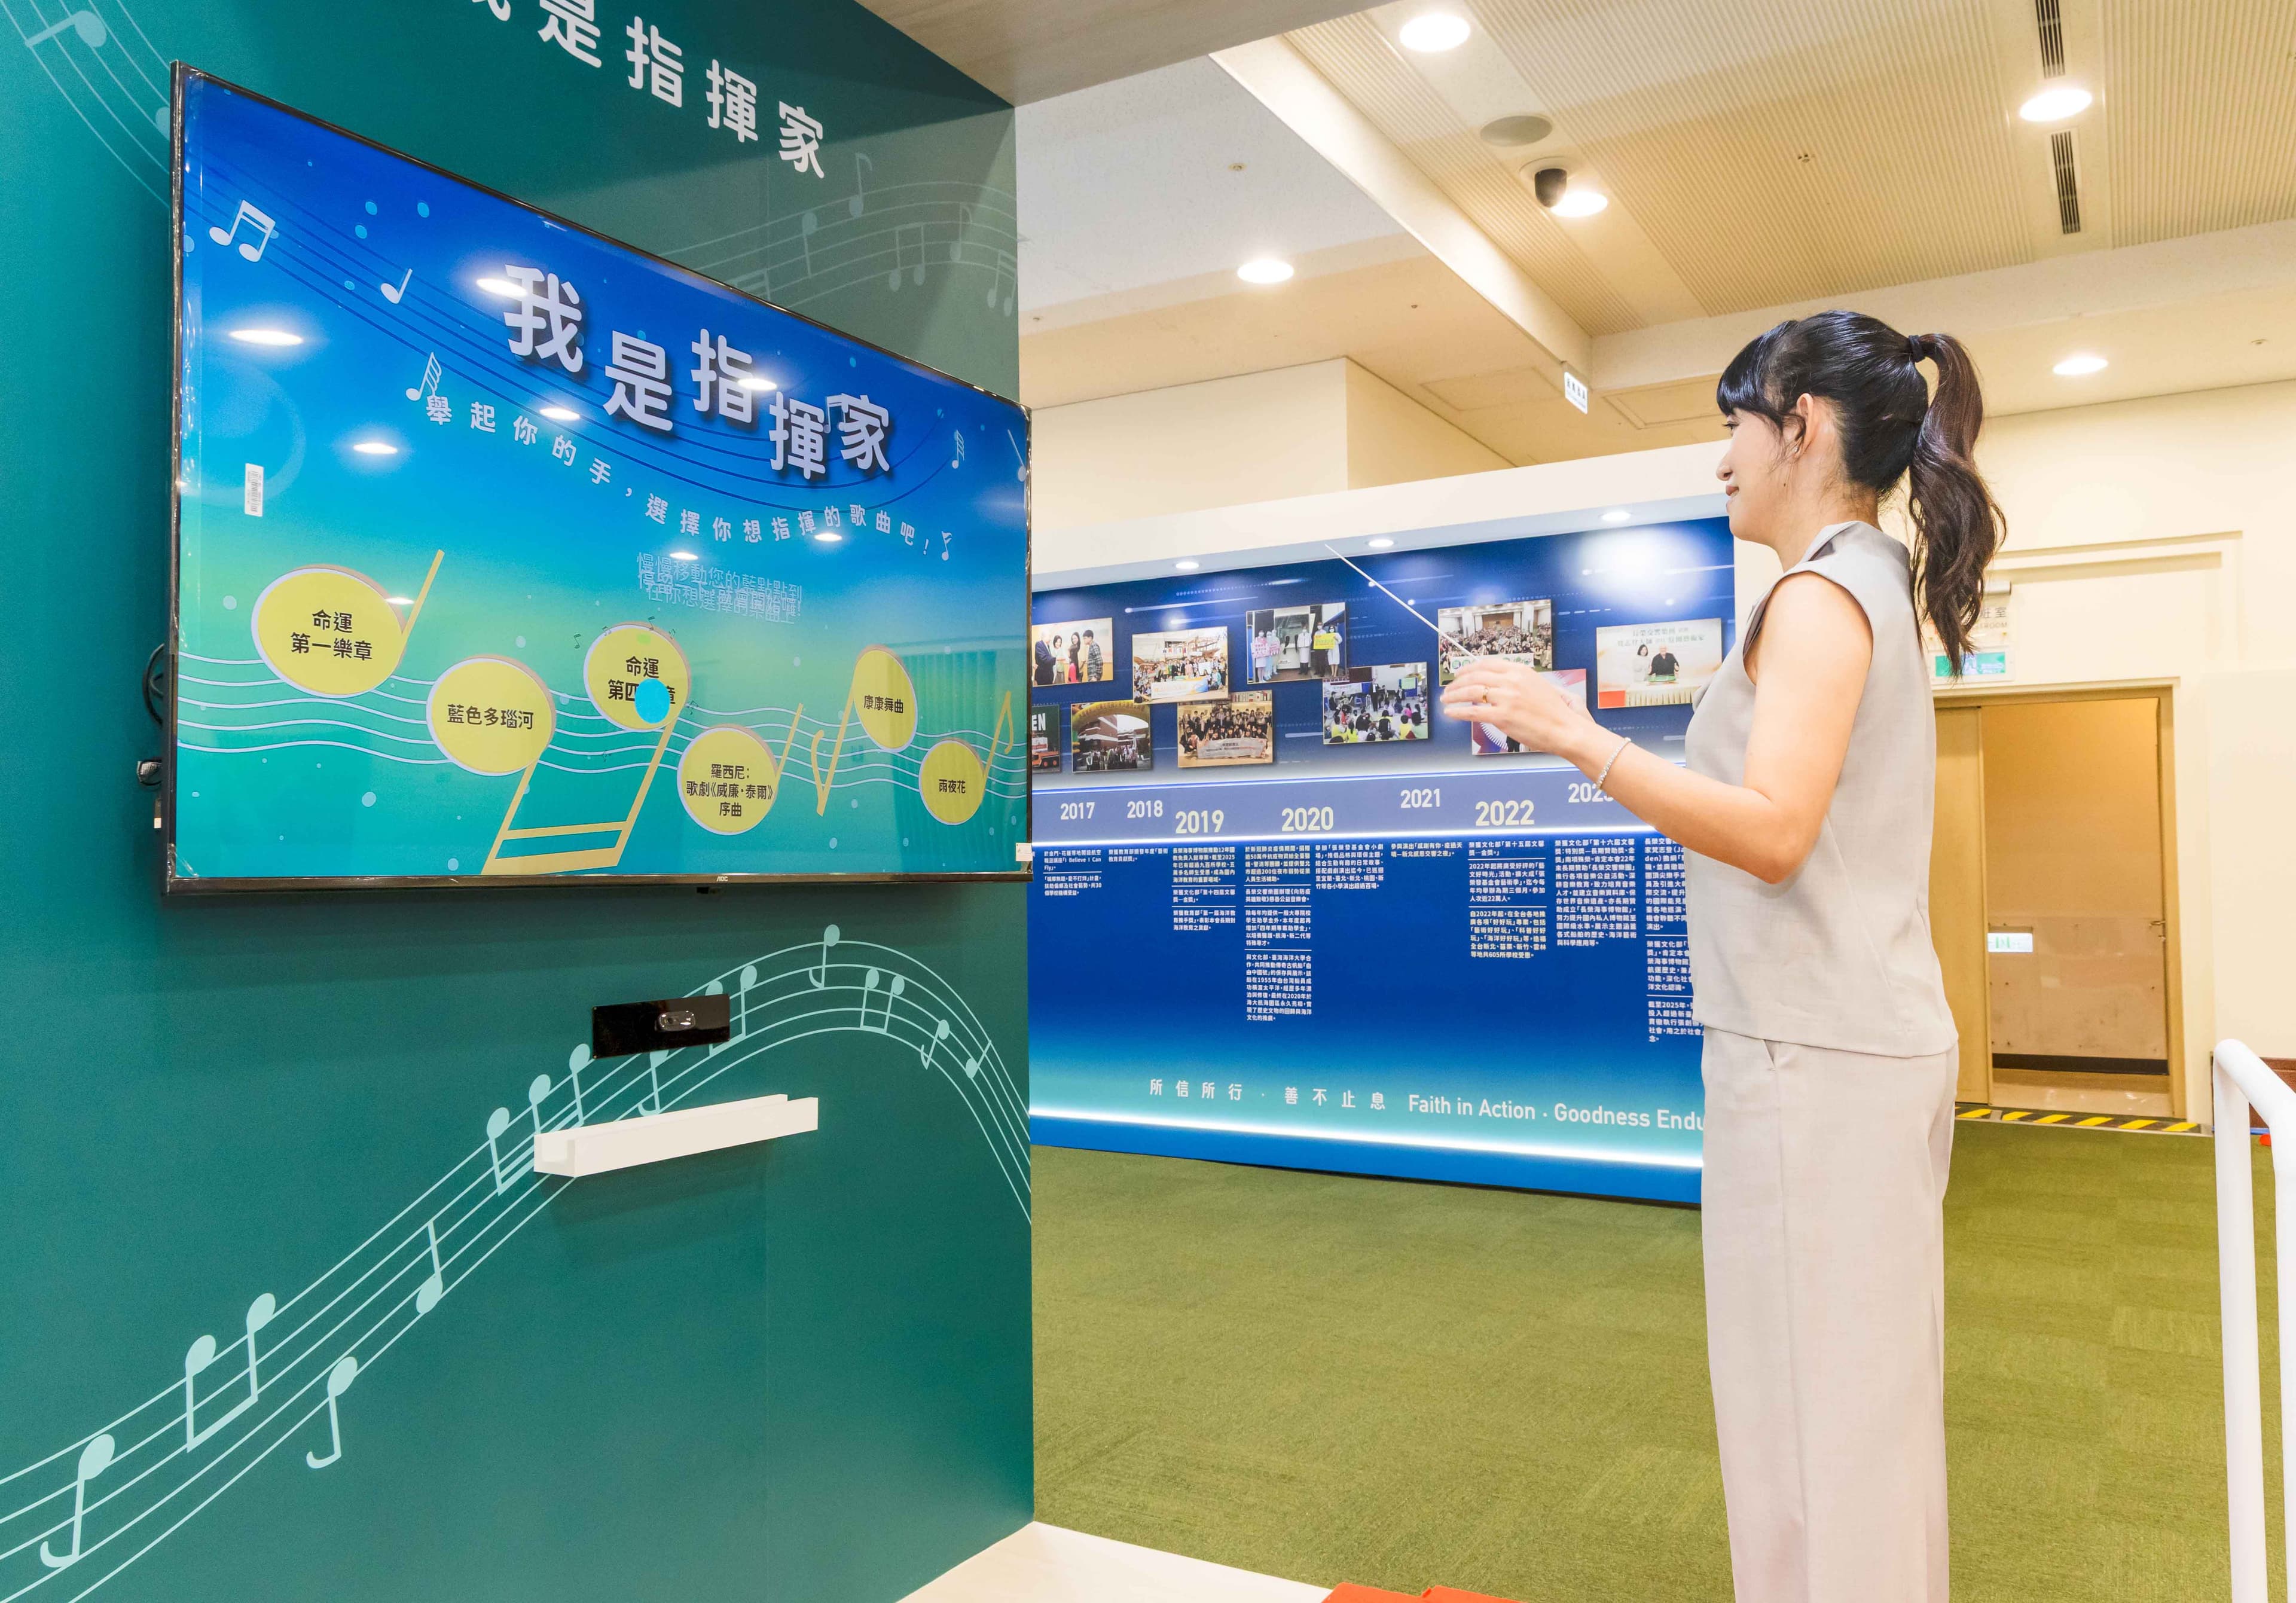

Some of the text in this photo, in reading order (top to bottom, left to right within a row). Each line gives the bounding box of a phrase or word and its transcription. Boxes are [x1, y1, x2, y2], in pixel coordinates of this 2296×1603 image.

[463, 0, 825, 178] 是指揮家
[504, 264, 890, 481] 我是指揮家
[312, 610, 353, 633] 命運
[291, 632, 373, 661] 第一樂章
[626, 656, 659, 679] 命運
[608, 679, 676, 704] 第四章
[864, 695, 904, 713] 康康舞曲
[447, 704, 535, 730] 藍色多瑙河
[939, 778, 966, 794] 雨夜花
[719, 802, 741, 817] 序曲
[1127, 800, 1163, 818] 2018
[1400, 789, 1441, 808] 2021
[1061, 802, 1095, 820] 2017
[1176, 810, 1224, 833] 2019
[1282, 807, 1333, 832] 2020
[1475, 799, 1535, 826] 2022
[1409, 1094, 1451, 1115] Faith
[1457, 1096, 1472, 1116] in
[1479, 1099, 1535, 1120] Action
[1555, 1103, 1650, 1128] Goodness
